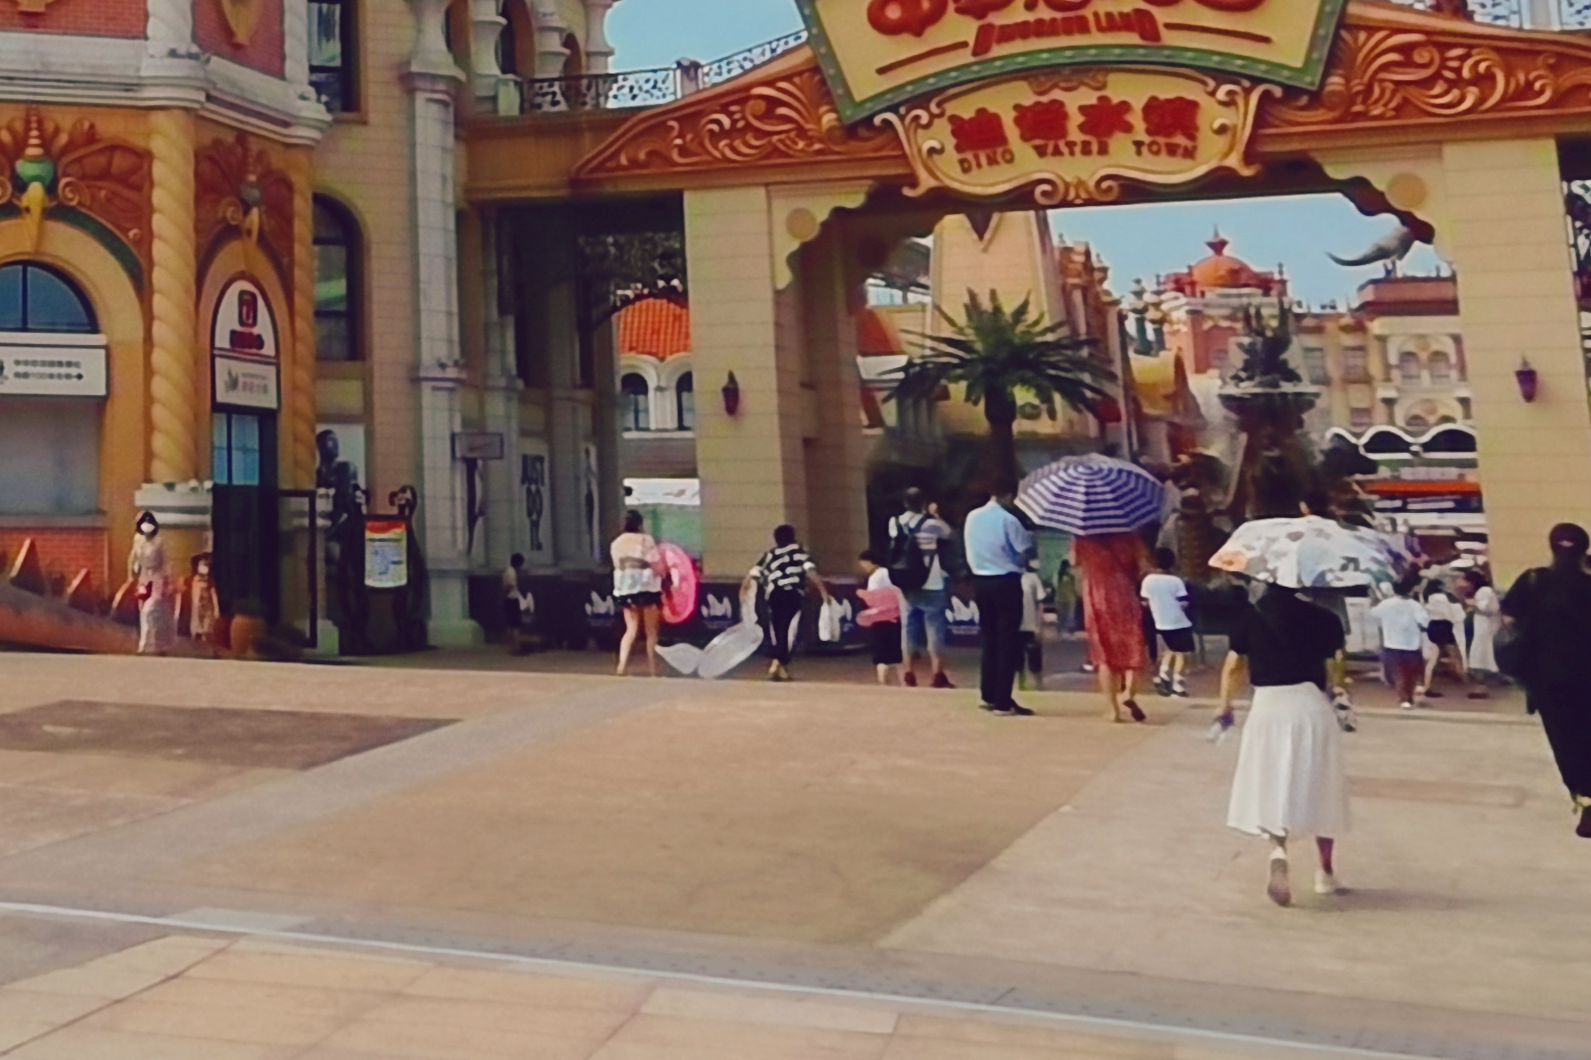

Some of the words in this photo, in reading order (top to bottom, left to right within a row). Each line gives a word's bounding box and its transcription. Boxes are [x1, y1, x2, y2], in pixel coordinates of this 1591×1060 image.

[1092, 8, 1161, 43] LAND
[957, 147, 1015, 175] DINO
[1031, 139, 1110, 159] WATER
[1131, 139, 1198, 161] TOWN
